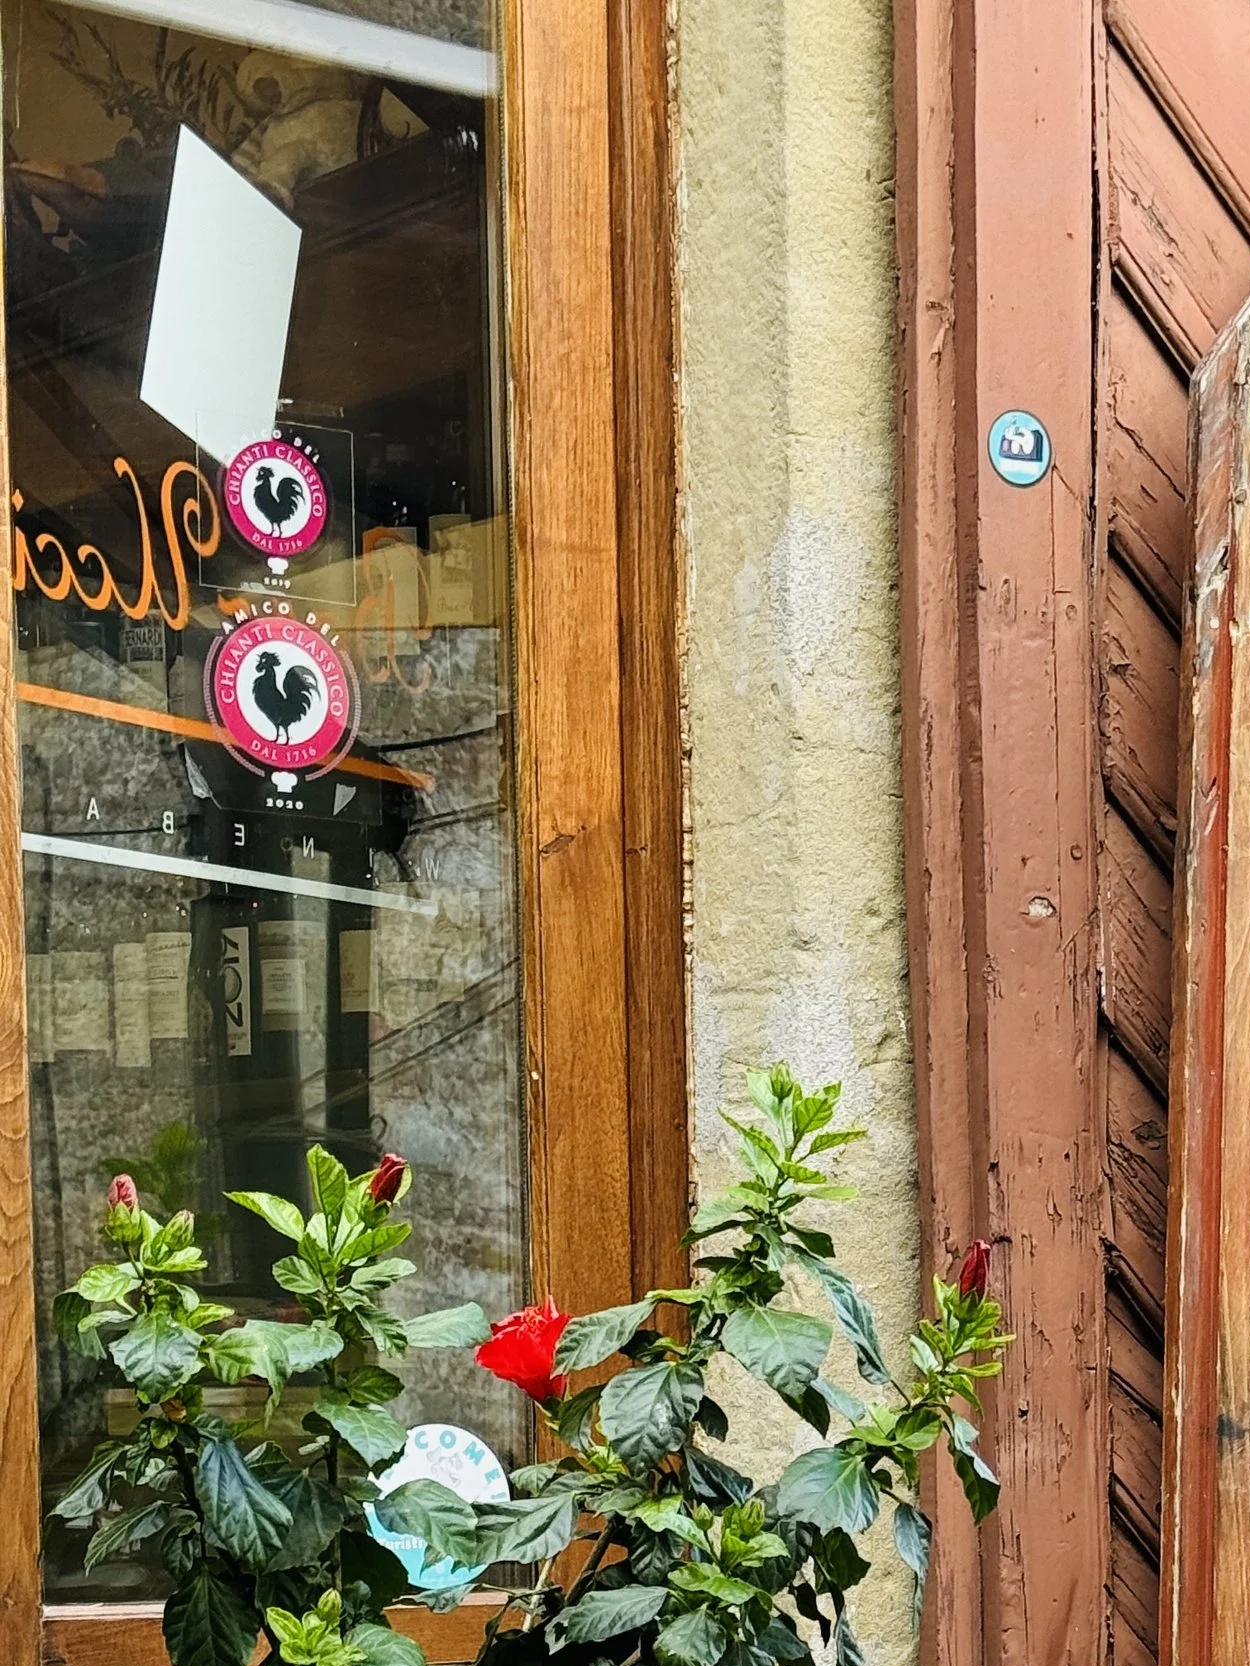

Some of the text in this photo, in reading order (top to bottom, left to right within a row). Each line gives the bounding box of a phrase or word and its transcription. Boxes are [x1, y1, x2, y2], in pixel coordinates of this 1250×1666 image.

[294, 437, 320, 463] DEL
[228, 444, 324, 517] CHIANTI CLASSICO
[252, 533, 304, 551] DAL 1716
[263, 577, 291, 589] 2019
[221, 601, 340, 647] AMICO DEL
[220, 626, 344, 717] CHIANTI CLASSICO
[251, 740, 317, 763] DAL 1716
[266, 799, 304, 810] 2020
